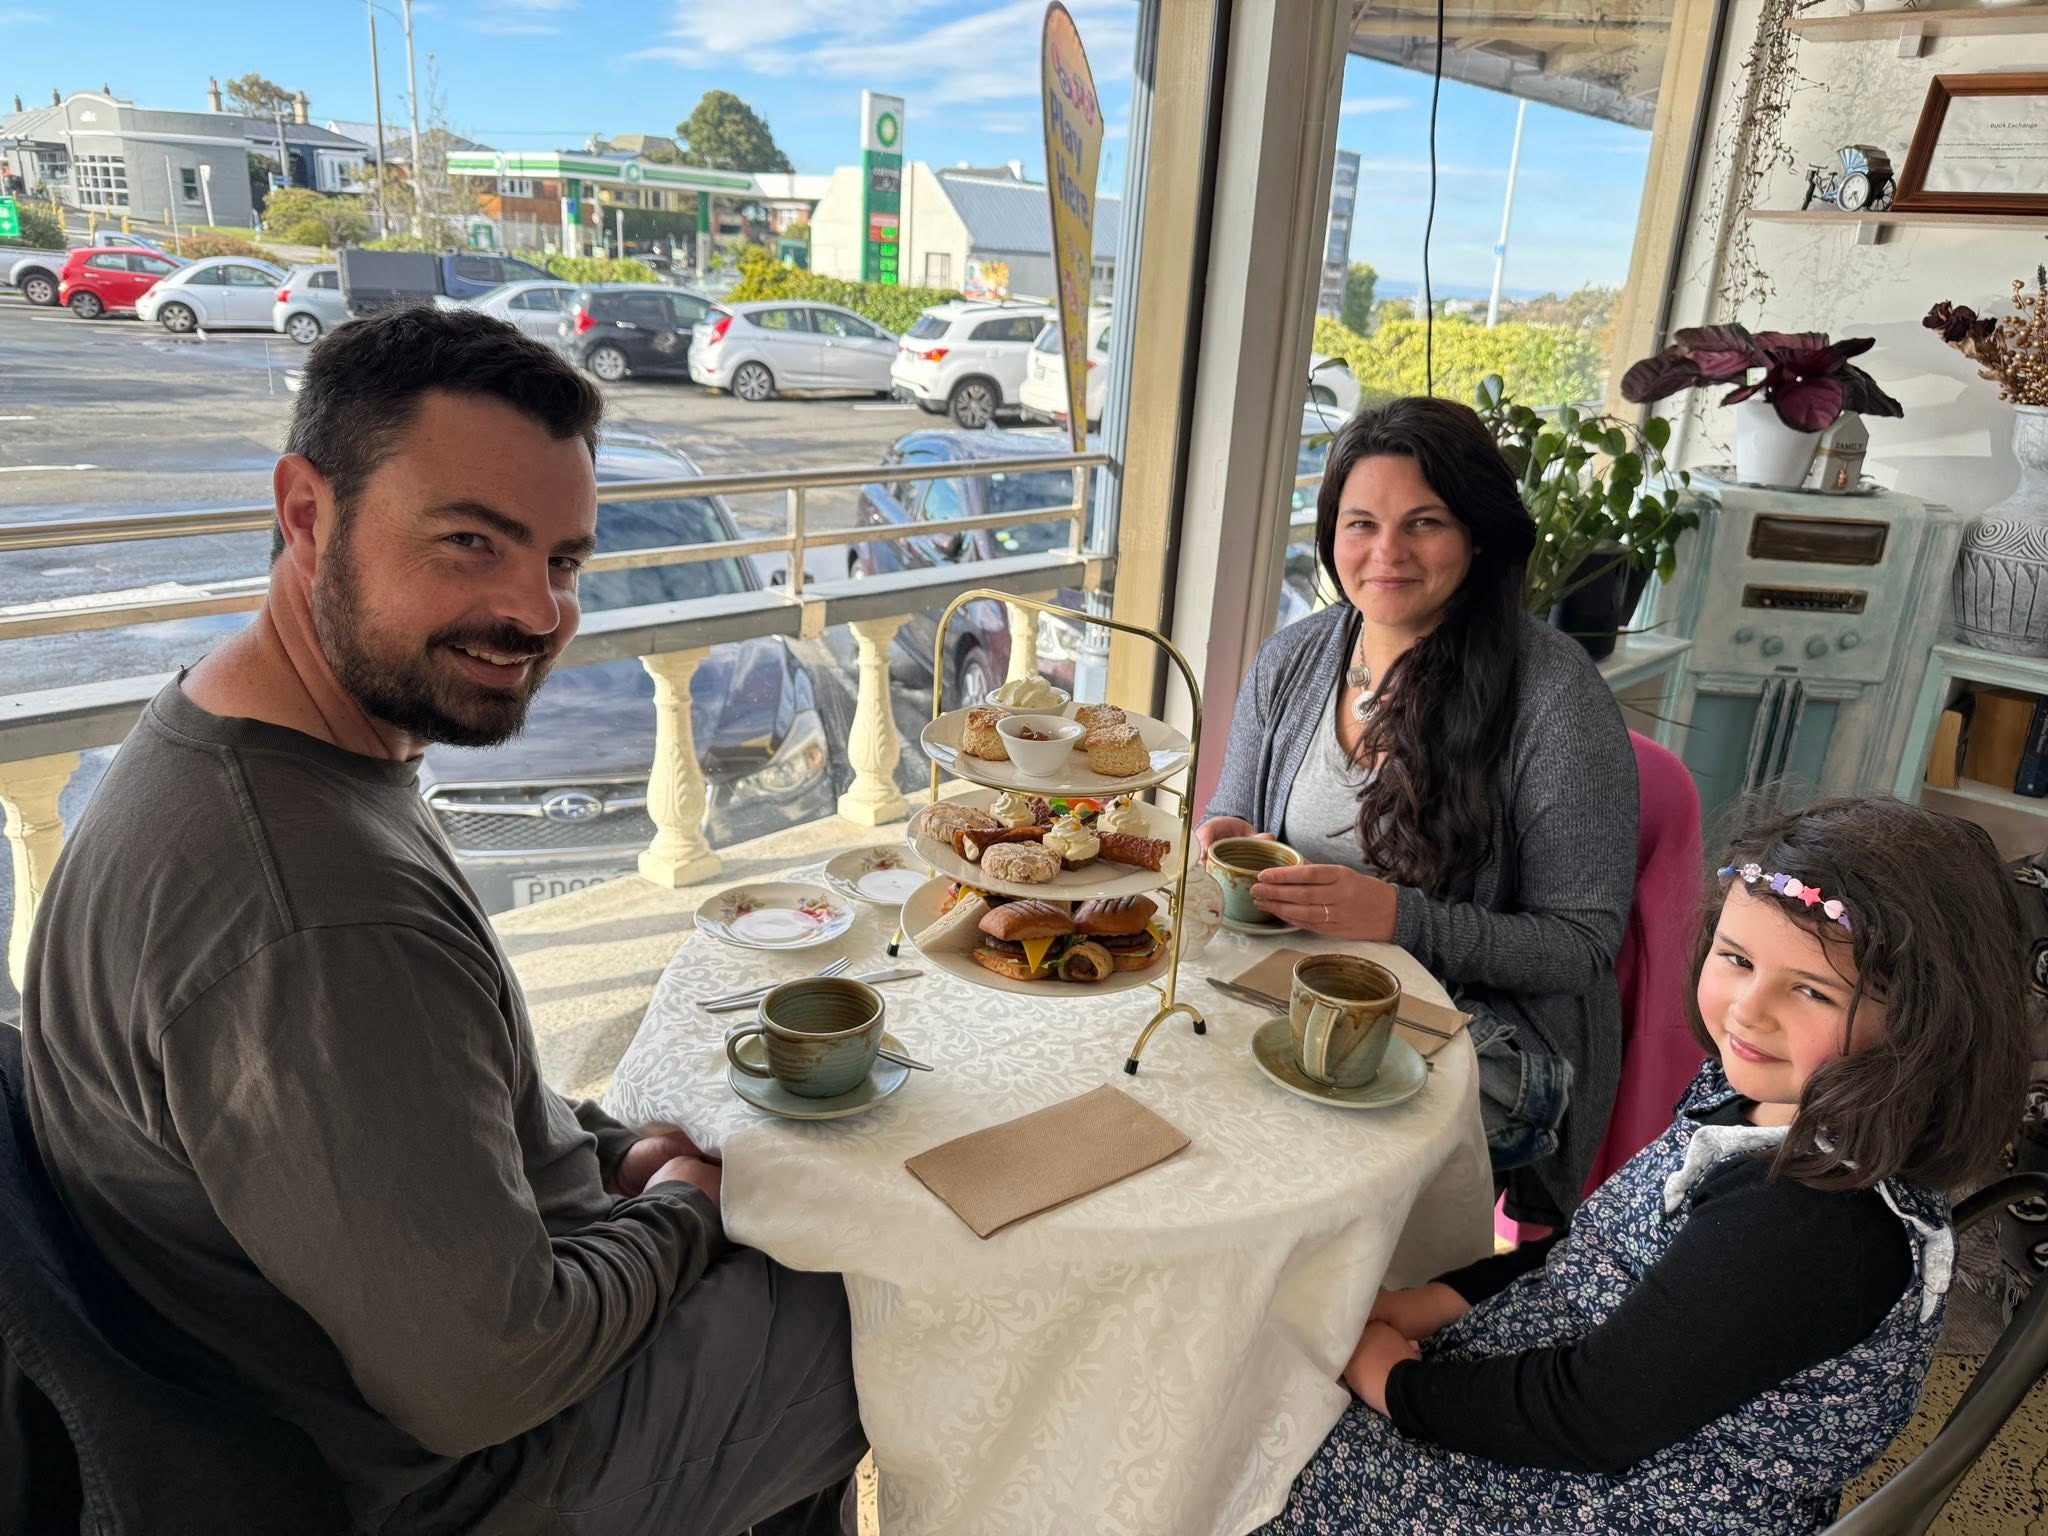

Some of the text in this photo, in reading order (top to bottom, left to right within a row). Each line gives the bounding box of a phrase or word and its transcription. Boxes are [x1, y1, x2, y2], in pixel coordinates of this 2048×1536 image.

[1050, 90, 1082, 176] Play
[2007, 121, 2039, 129] Exchange
[1056, 151, 1089, 229] Here
[1835, 442, 1864, 450] FAMILY
